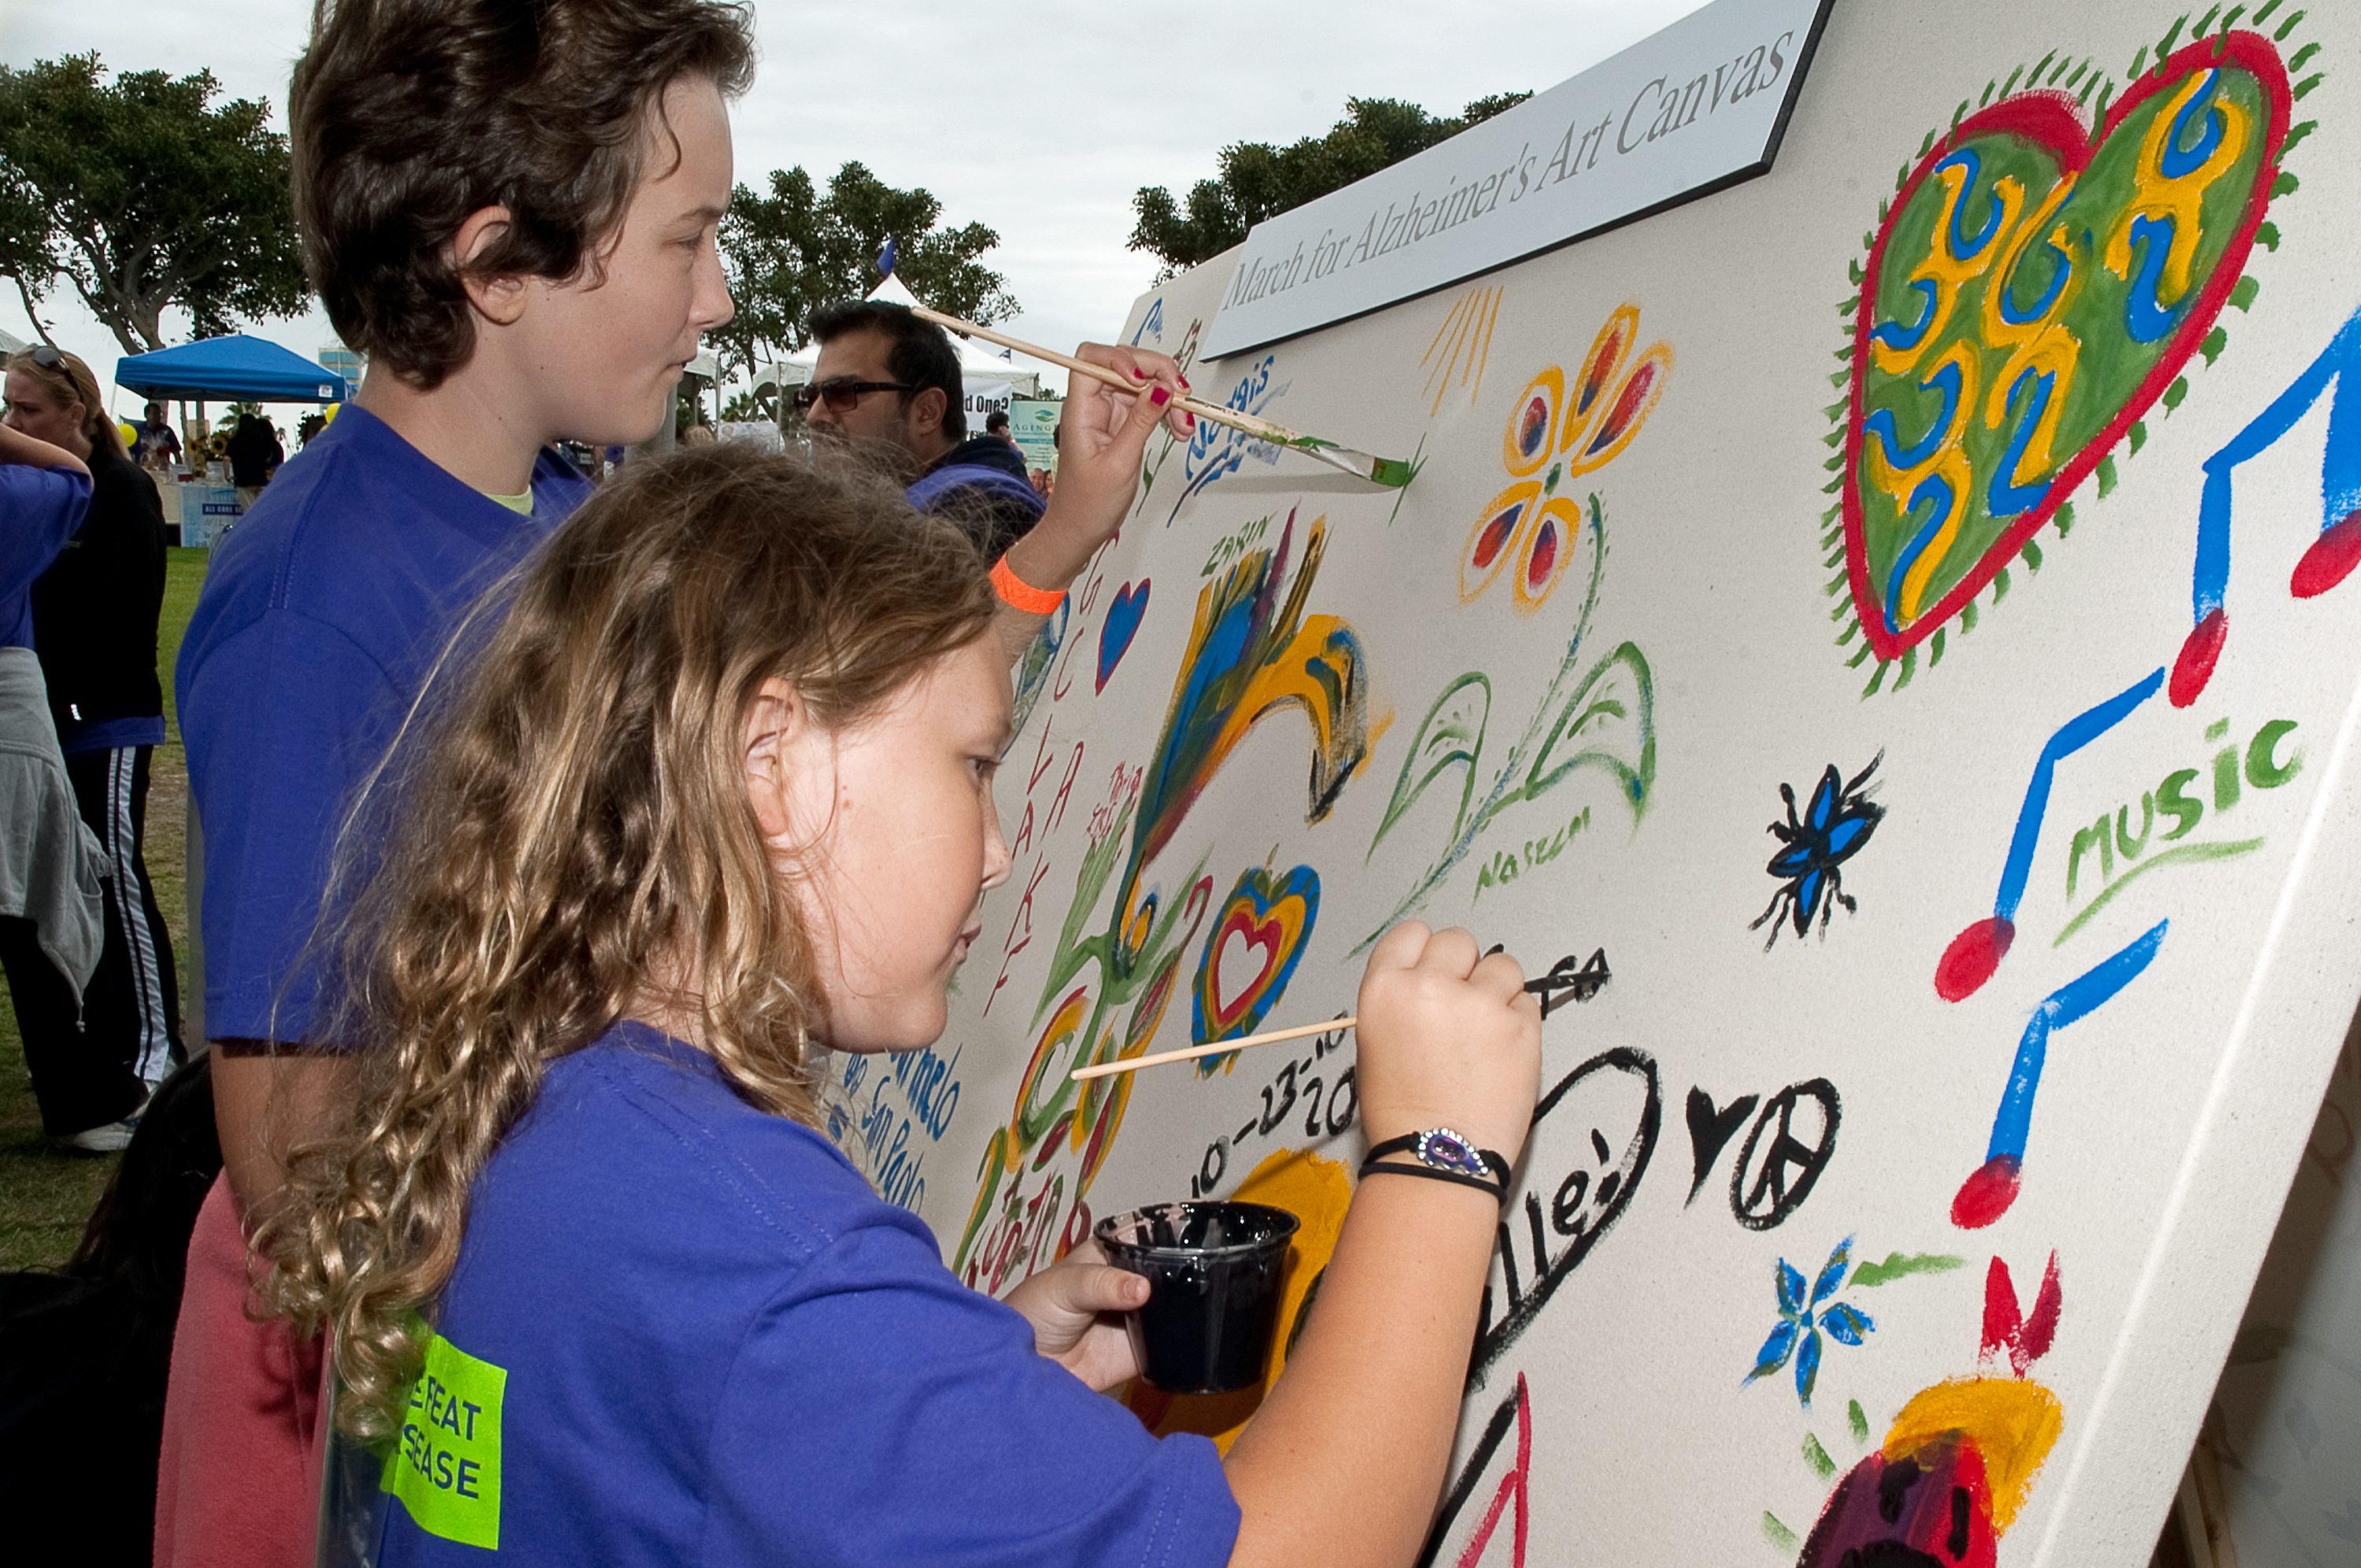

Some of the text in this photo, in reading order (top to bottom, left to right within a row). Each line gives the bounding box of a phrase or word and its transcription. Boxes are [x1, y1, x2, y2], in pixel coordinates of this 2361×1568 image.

[1221, 30, 1794, 309] March for Alzheimer's Art Canvas
